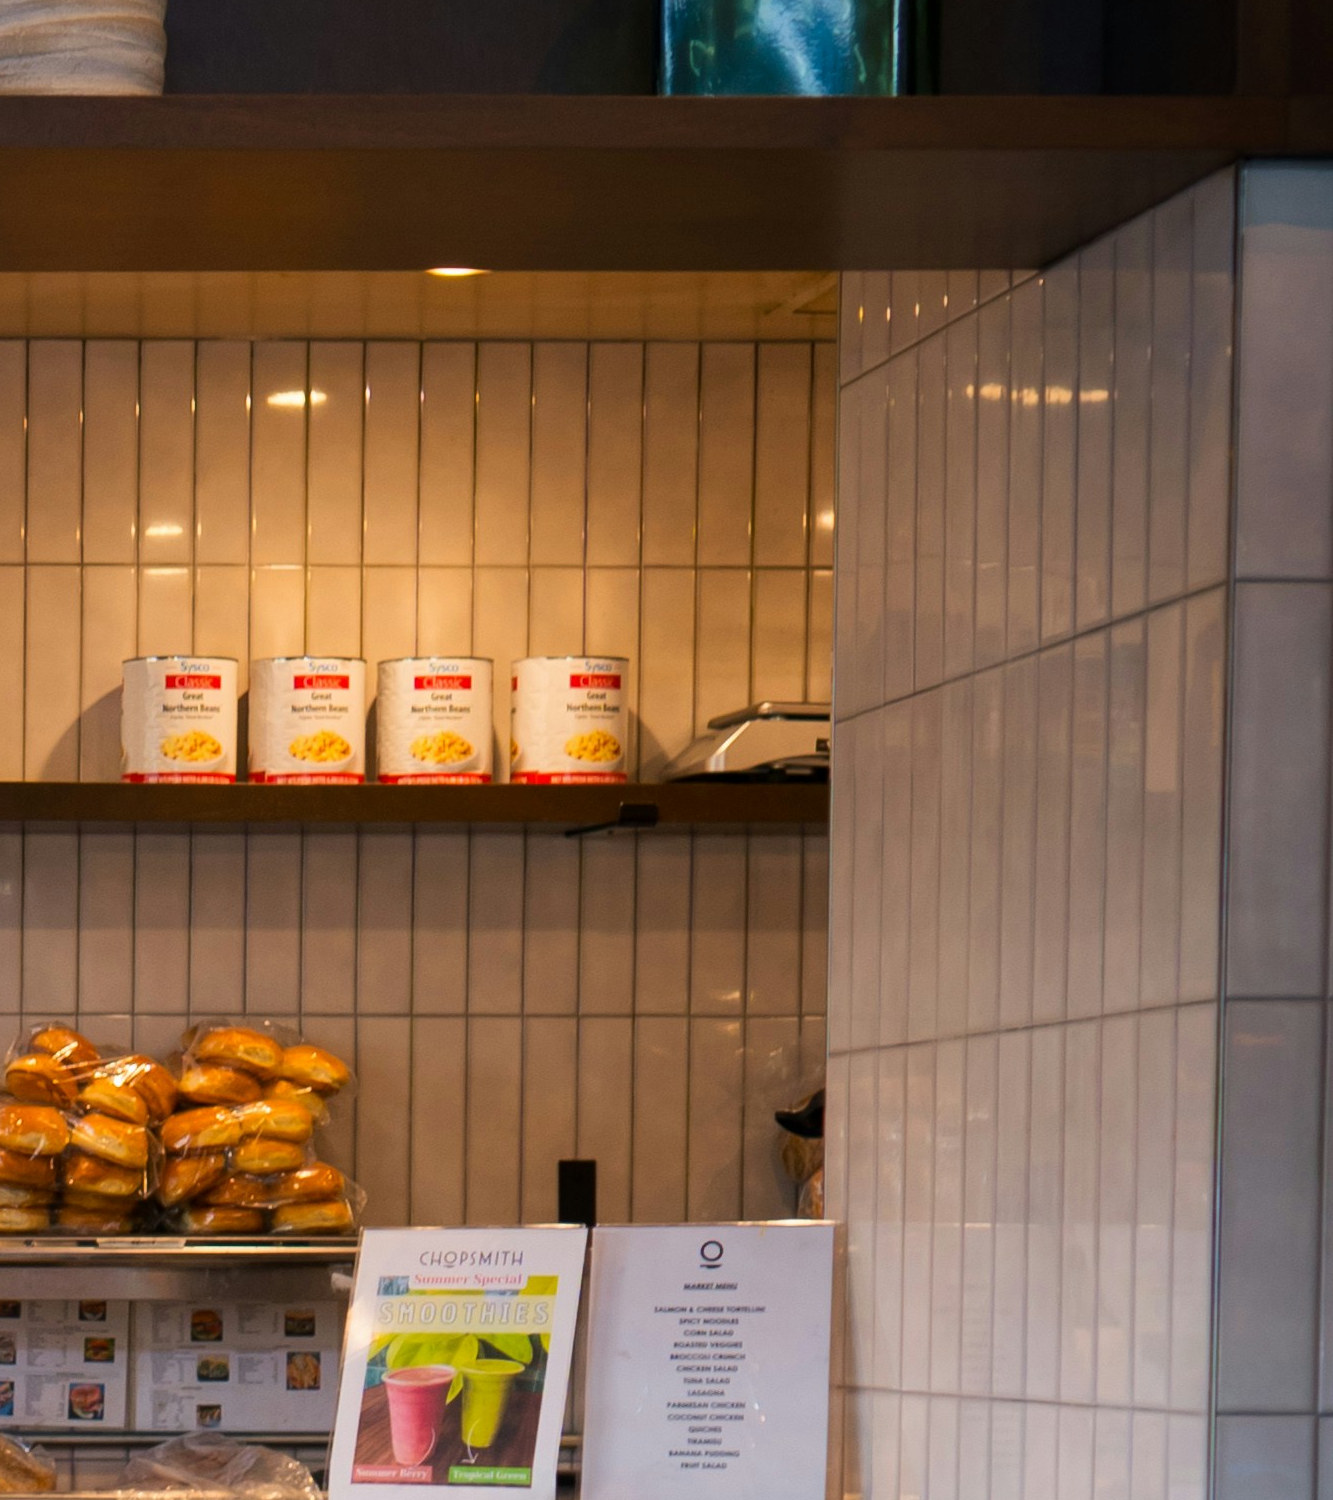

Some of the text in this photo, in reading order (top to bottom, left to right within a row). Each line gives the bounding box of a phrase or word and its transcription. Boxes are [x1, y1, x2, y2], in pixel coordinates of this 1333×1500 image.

[175, 676, 213, 688] Classic
[303, 676, 342, 688] Classic
[423, 677, 463, 689] Classic
[579, 675, 614, 688] Classic
[183, 691, 203, 700] Great
[311, 691, 332, 700] Great
[431, 692, 452, 701] Great
[587, 691, 607, 700] Great
[163, 704, 220, 713] Northern Beans
[291, 704, 348, 713] Northern Beans
[411, 704, 470, 713] Northern Beans
[567, 703, 620, 713] Northern Beans
[420, 1251, 524, 1268] CHOPSMITH
[413, 1273, 523, 1287] Summer Special
[379, 1301, 550, 1325] SMOOTHIES
[356, 1467, 428, 1481] Summer Berry
[451, 1470, 528, 1482] Tropical Green
